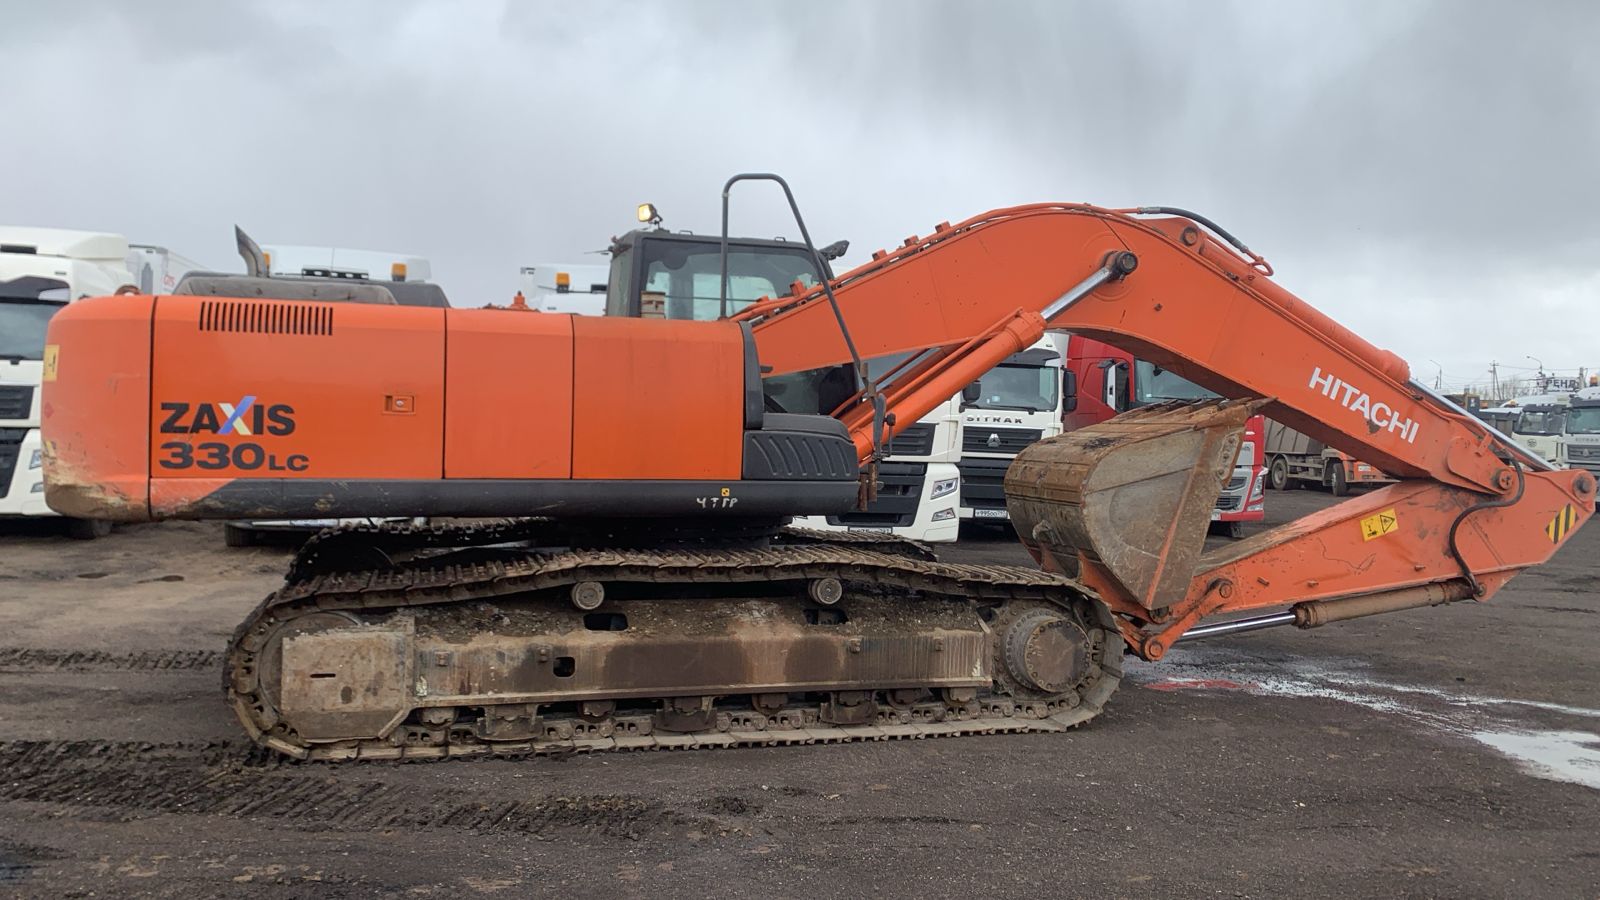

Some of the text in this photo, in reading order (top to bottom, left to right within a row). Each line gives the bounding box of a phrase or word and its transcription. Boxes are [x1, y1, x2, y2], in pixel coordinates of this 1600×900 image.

[160, 396, 296, 436] ZAXIS
[966, 416, 1023, 424] SITRAK
[1309, 367, 1420, 444] HITACHI
